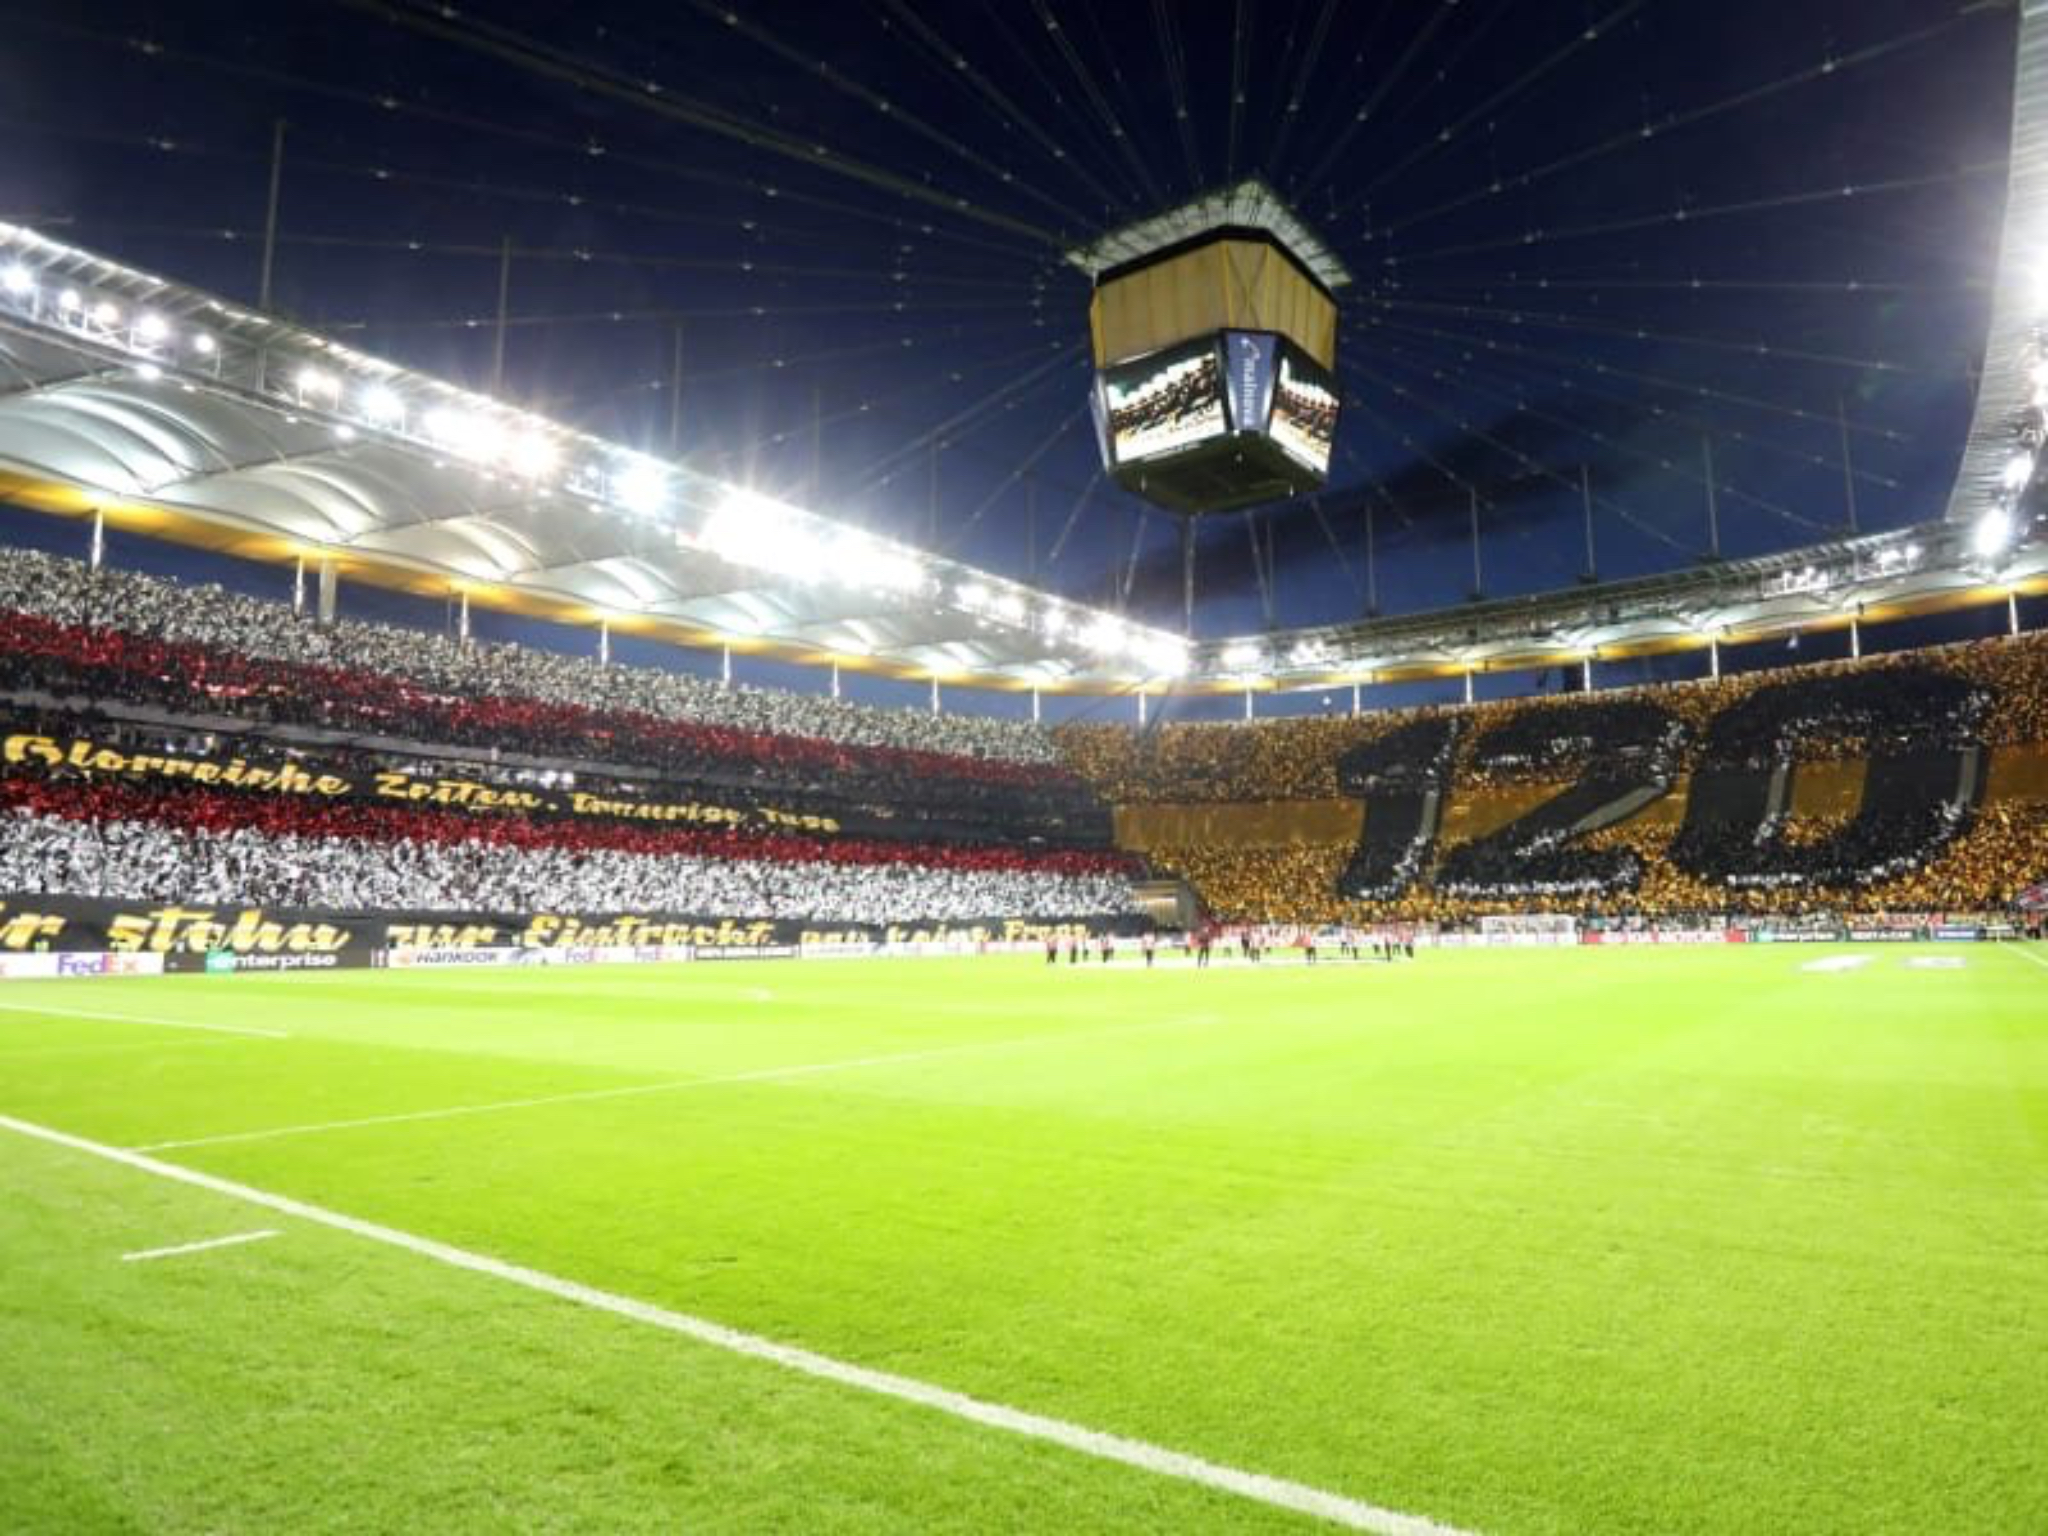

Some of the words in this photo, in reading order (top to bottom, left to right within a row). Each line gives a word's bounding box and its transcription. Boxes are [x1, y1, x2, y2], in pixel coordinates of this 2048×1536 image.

[3, 734, 352, 796] Glorreiche
[1334, 672, 1992, 899] 120
[58, 954, 138, 976] FedEx
